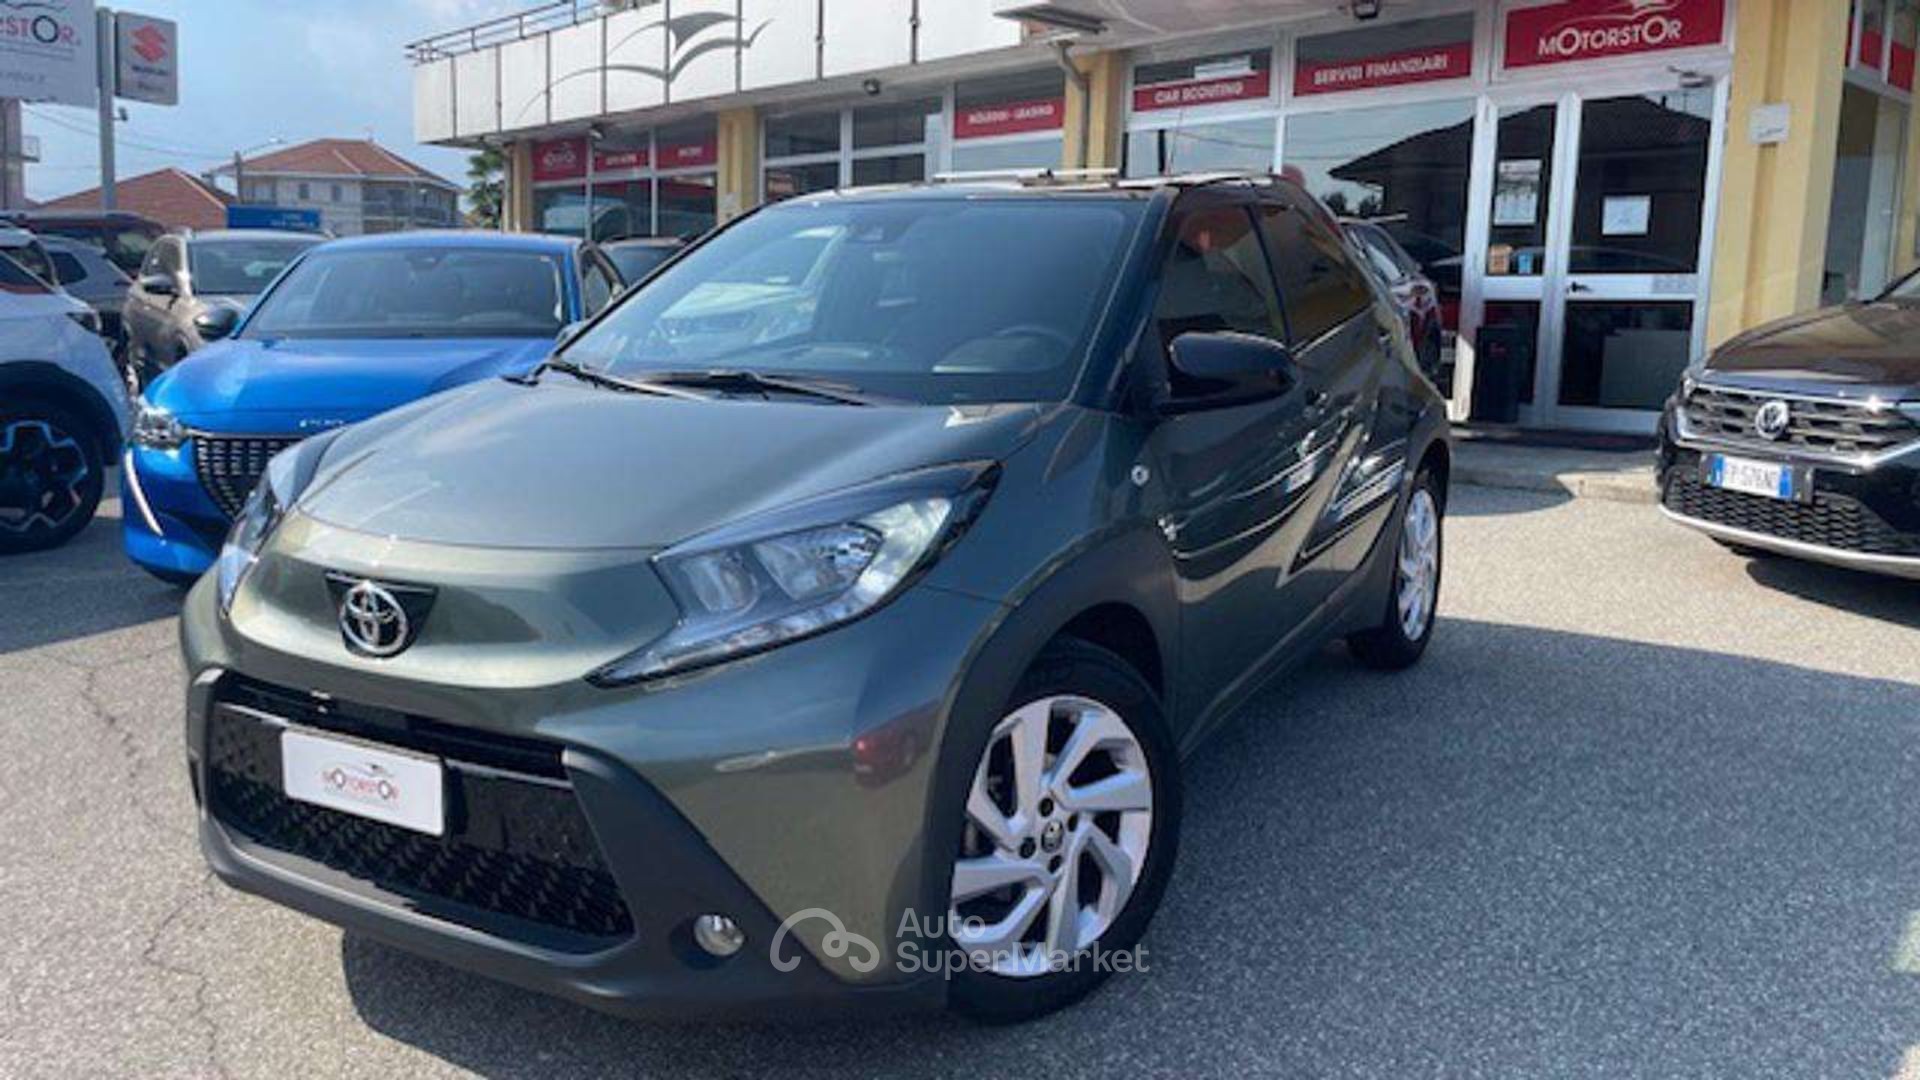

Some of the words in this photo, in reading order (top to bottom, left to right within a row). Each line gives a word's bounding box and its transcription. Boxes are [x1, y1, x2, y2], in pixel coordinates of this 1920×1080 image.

[1538, 15, 1682, 55] MOTORSTOR
[1365, 54, 1448, 78] FINANZIARI
[1154, 88, 1180, 103] CAR
